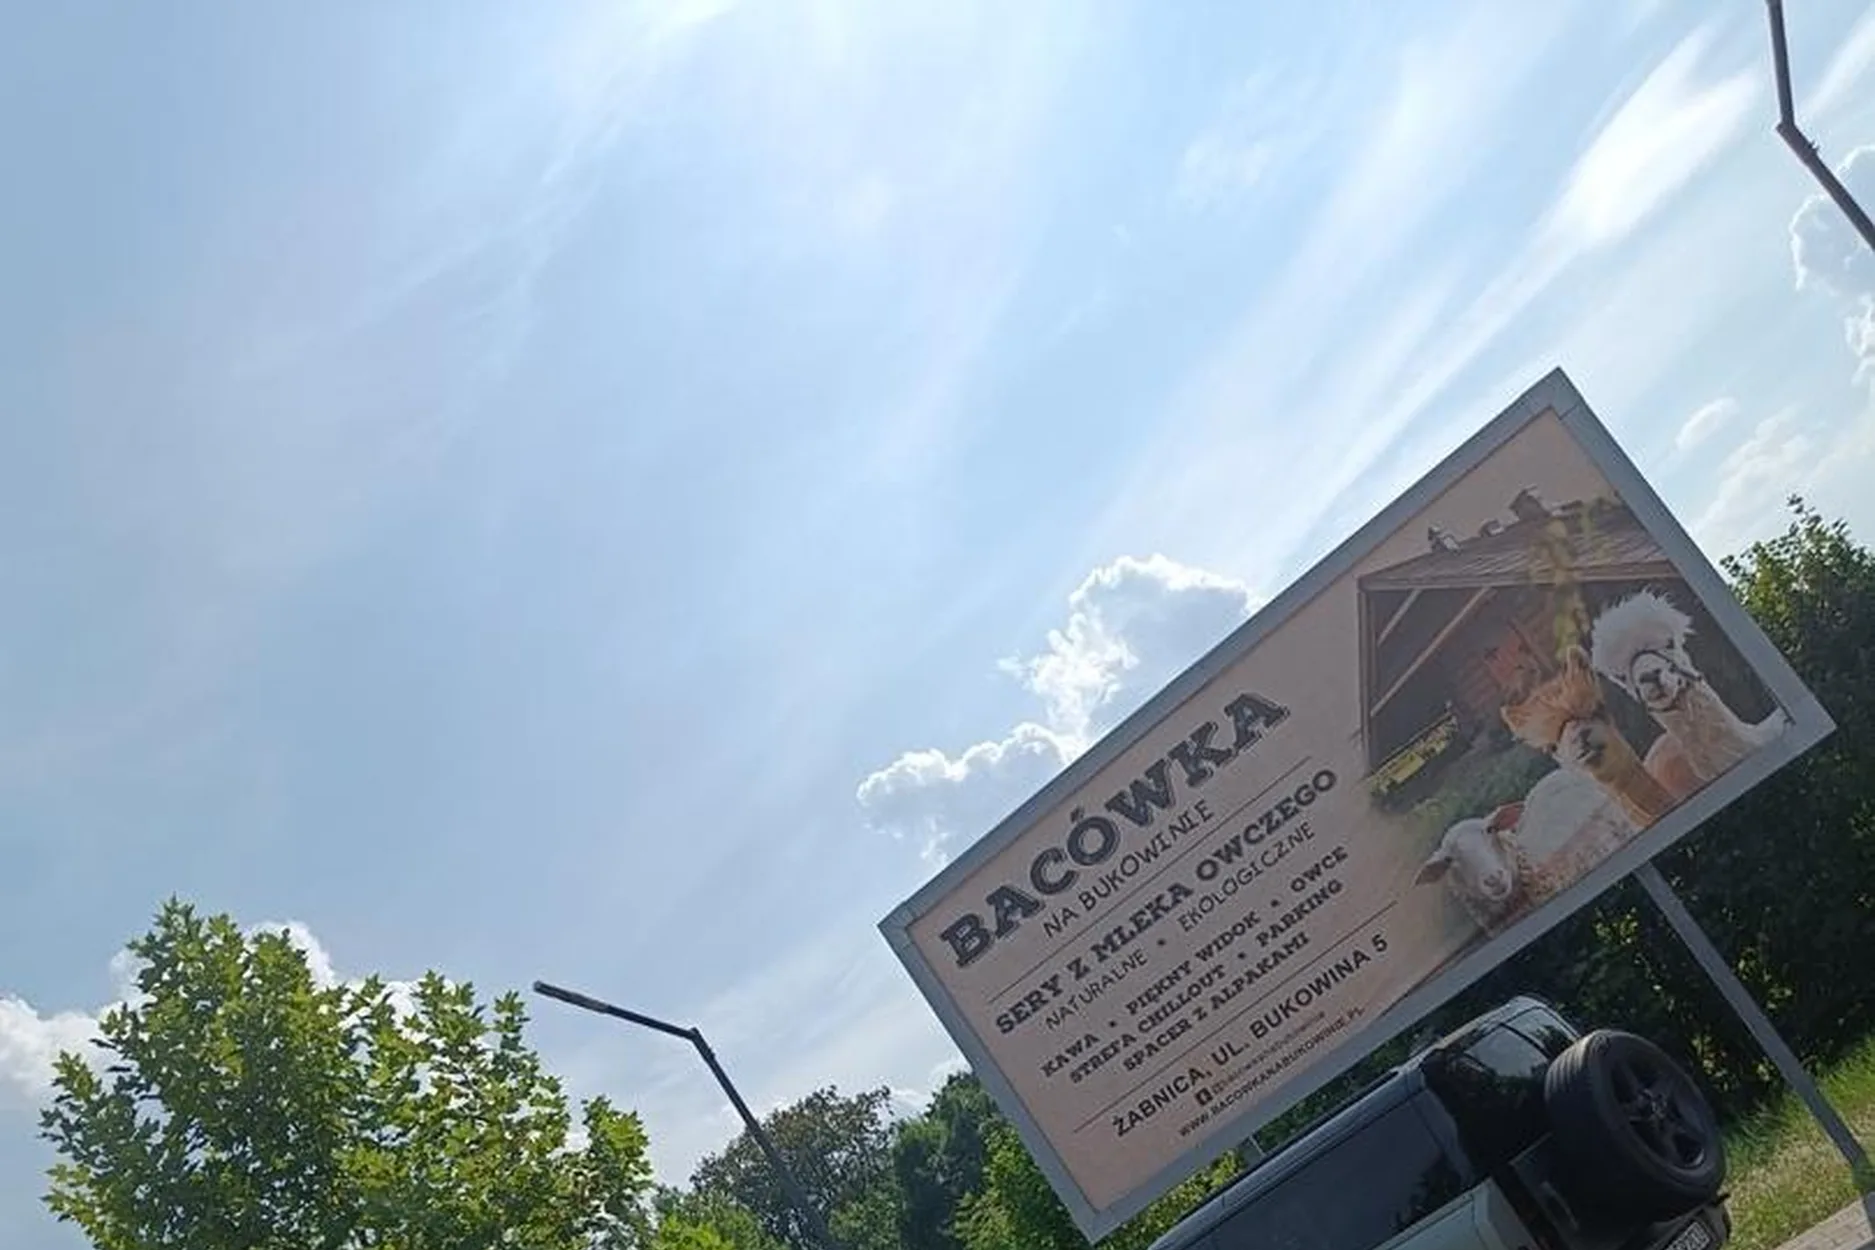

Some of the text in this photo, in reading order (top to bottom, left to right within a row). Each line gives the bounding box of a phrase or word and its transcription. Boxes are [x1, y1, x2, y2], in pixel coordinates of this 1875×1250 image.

[940, 693, 1290, 967] BACÓWKA
[996, 770, 1337, 1034] SERY Z MLEKA OWCZEGO
[1043, 800, 1214, 938] NA BUKOWINIE
[1046, 822, 1315, 1030] NATURALNE EKOLOGICZNE
[1040, 846, 1348, 1078] KAWA PIĘKNY WIDOK OWCE
[1070, 1033, 1137, 1084] STREFA
[1137, 964, 1226, 1033] CHILLOUT
[1256, 879, 1344, 947] PARKING
[1112, 1067, 1212, 1137] ŻABNICA,
[1211, 1041, 1250, 1066] UL.
[1250, 948, 1372, 1040] BUKOWINA
[1371, 933, 1388, 952] 5
[1123, 1018, 1193, 1071] SPACER
[1192, 1007, 1209, 1021] Z
[1210, 931, 1310, 1010] ALPAKAMI
